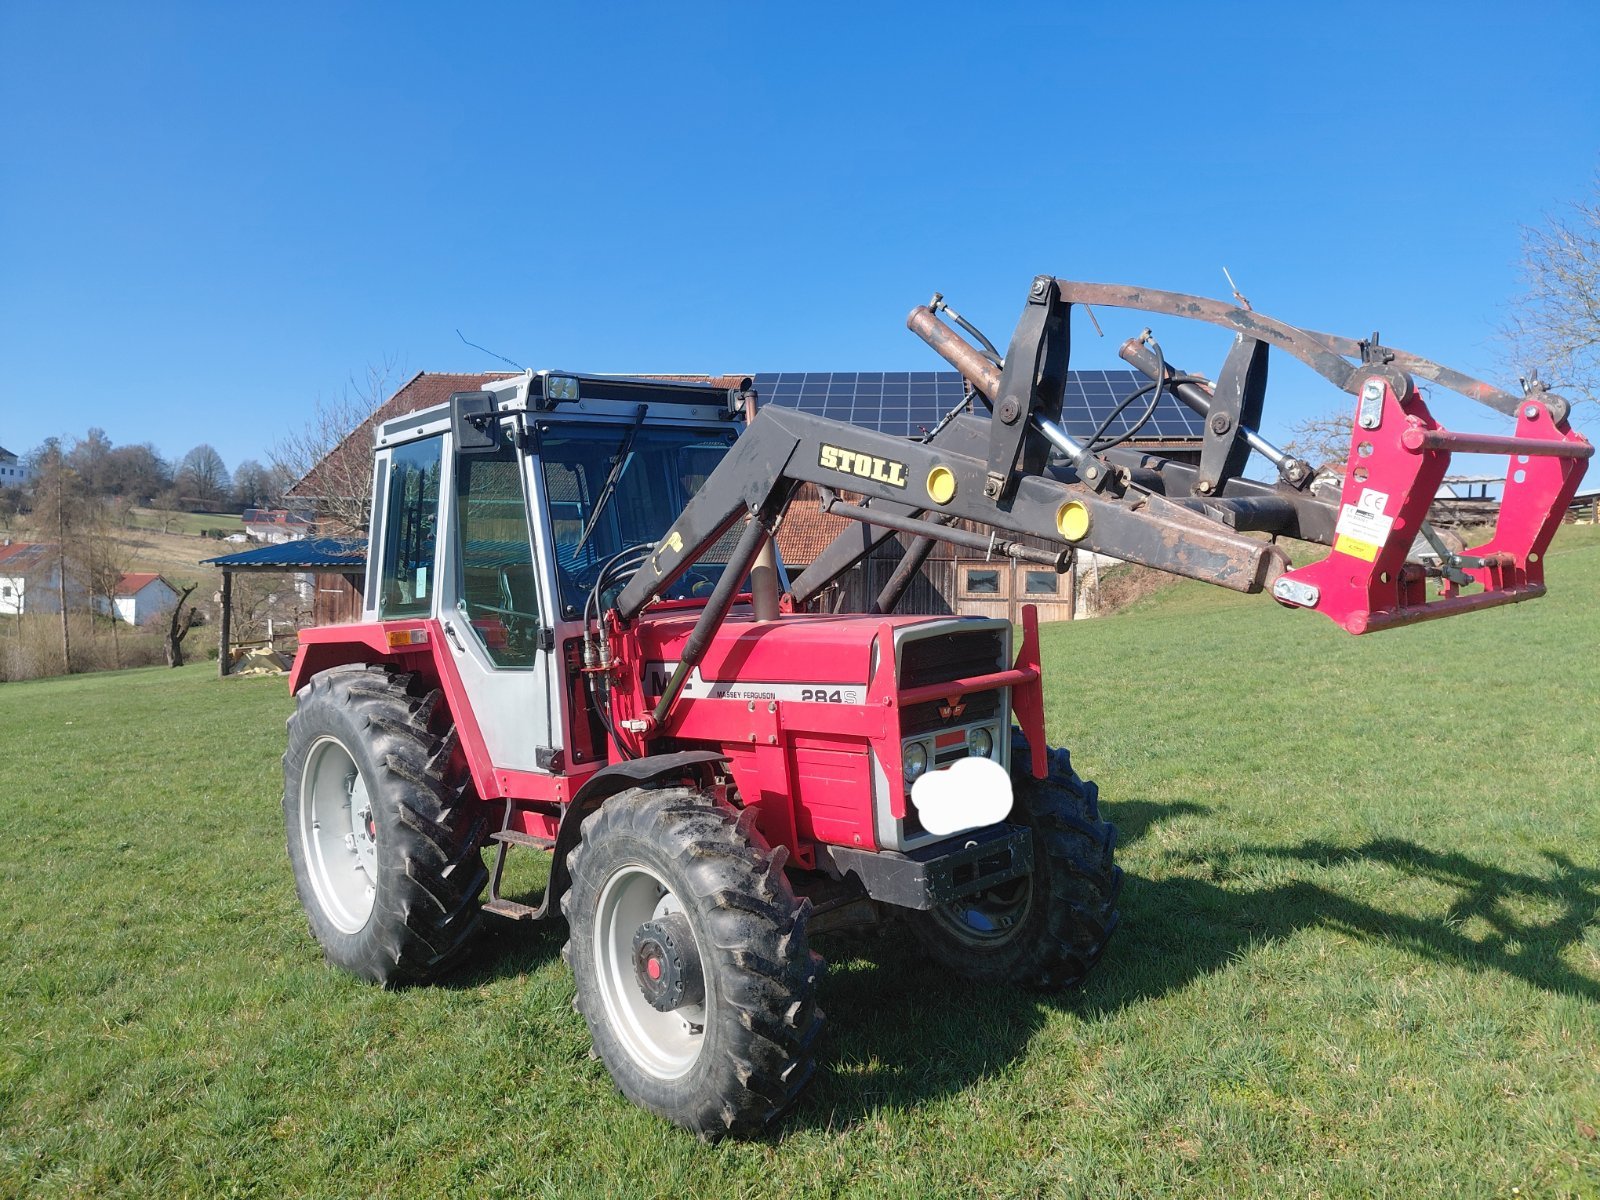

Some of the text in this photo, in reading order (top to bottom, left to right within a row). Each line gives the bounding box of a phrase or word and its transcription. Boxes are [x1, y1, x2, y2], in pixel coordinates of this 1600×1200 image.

[820, 445, 905, 487] STOLL
[1364, 494, 1384, 510] CE
[717, 691, 776, 700] MASSEY FERGUSON
[801, 689, 858, 704] 284S
